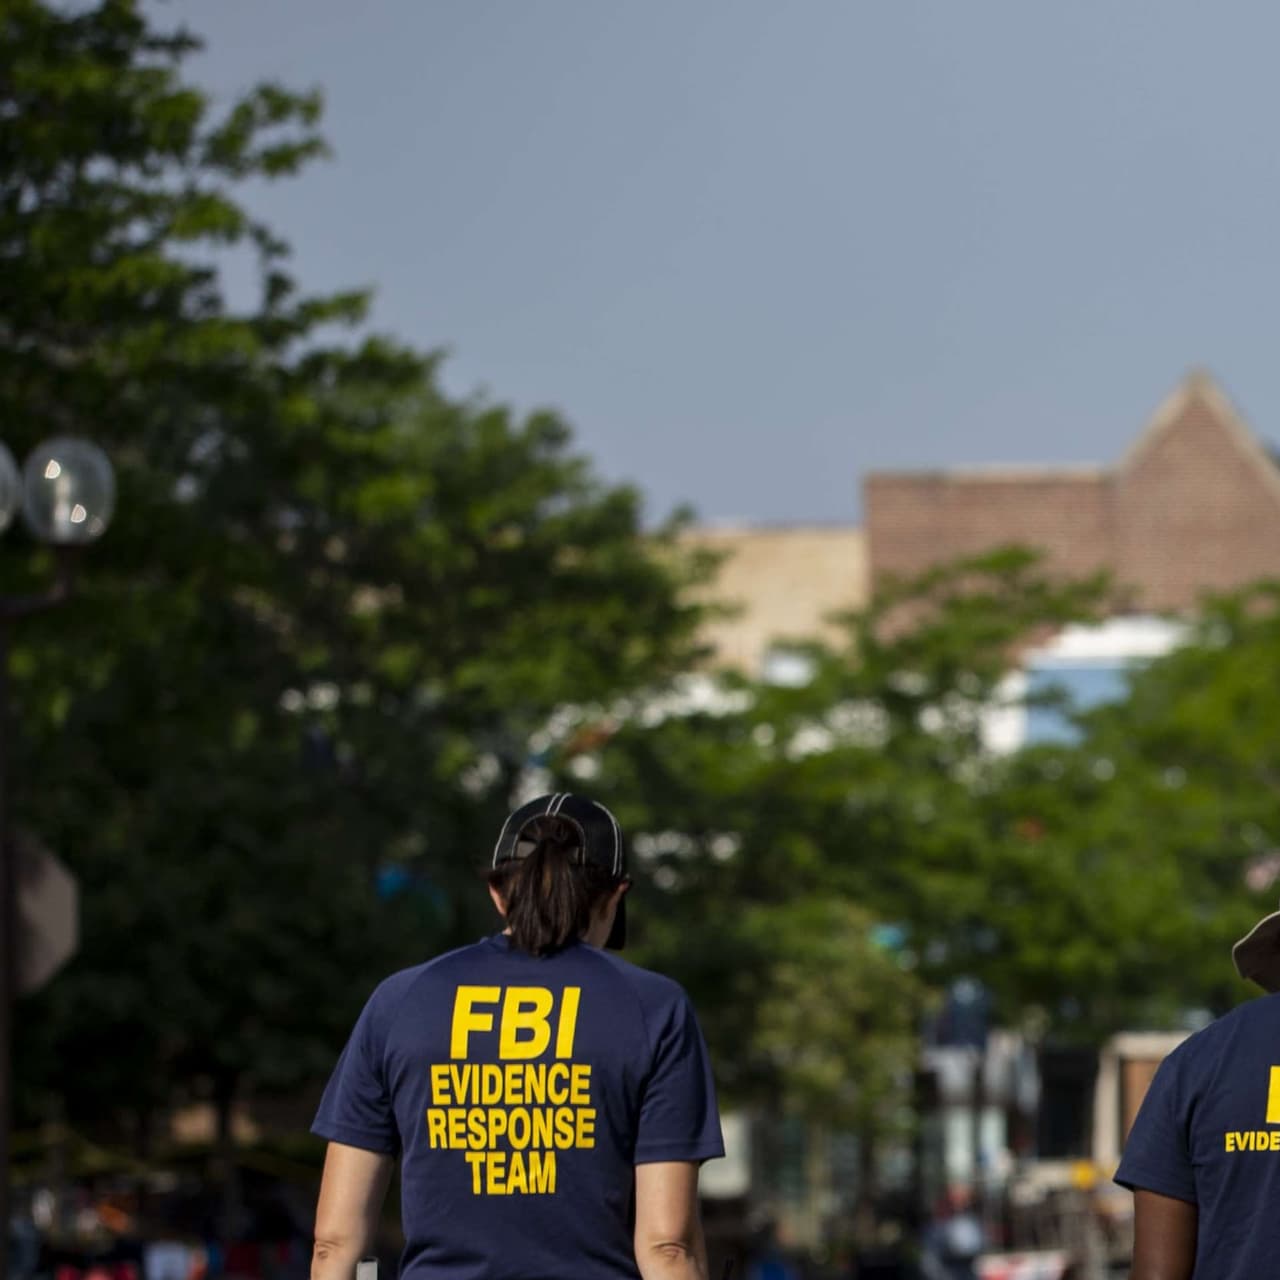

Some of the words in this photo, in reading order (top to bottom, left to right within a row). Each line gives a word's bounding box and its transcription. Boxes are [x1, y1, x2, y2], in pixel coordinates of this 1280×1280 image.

[449, 985, 581, 1060] FBI
[430, 1062, 592, 1105] EVIDENCE
[426, 1107, 597, 1150] RESPONSE
[464, 1151, 557, 1194] TEAM
